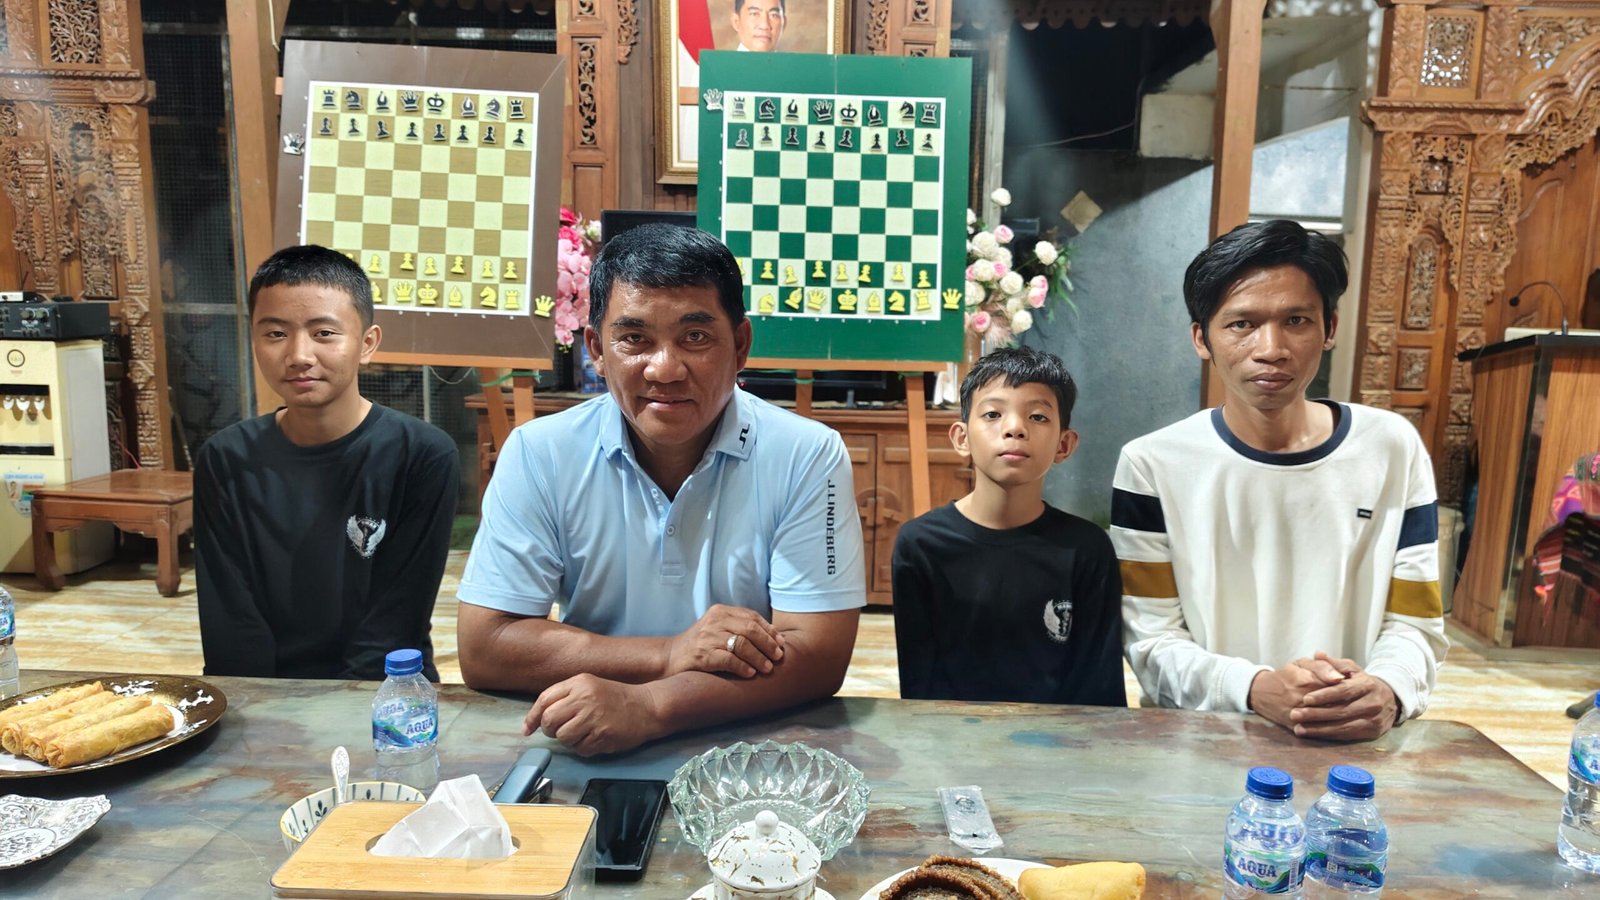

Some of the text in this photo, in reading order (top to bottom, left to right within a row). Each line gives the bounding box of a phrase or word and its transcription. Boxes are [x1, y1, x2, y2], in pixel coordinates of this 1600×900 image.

[826, 479, 836, 575] J.LINDEBERG
[405, 717, 434, 735] AQUA
[1237, 857, 1278, 879] AQUA
